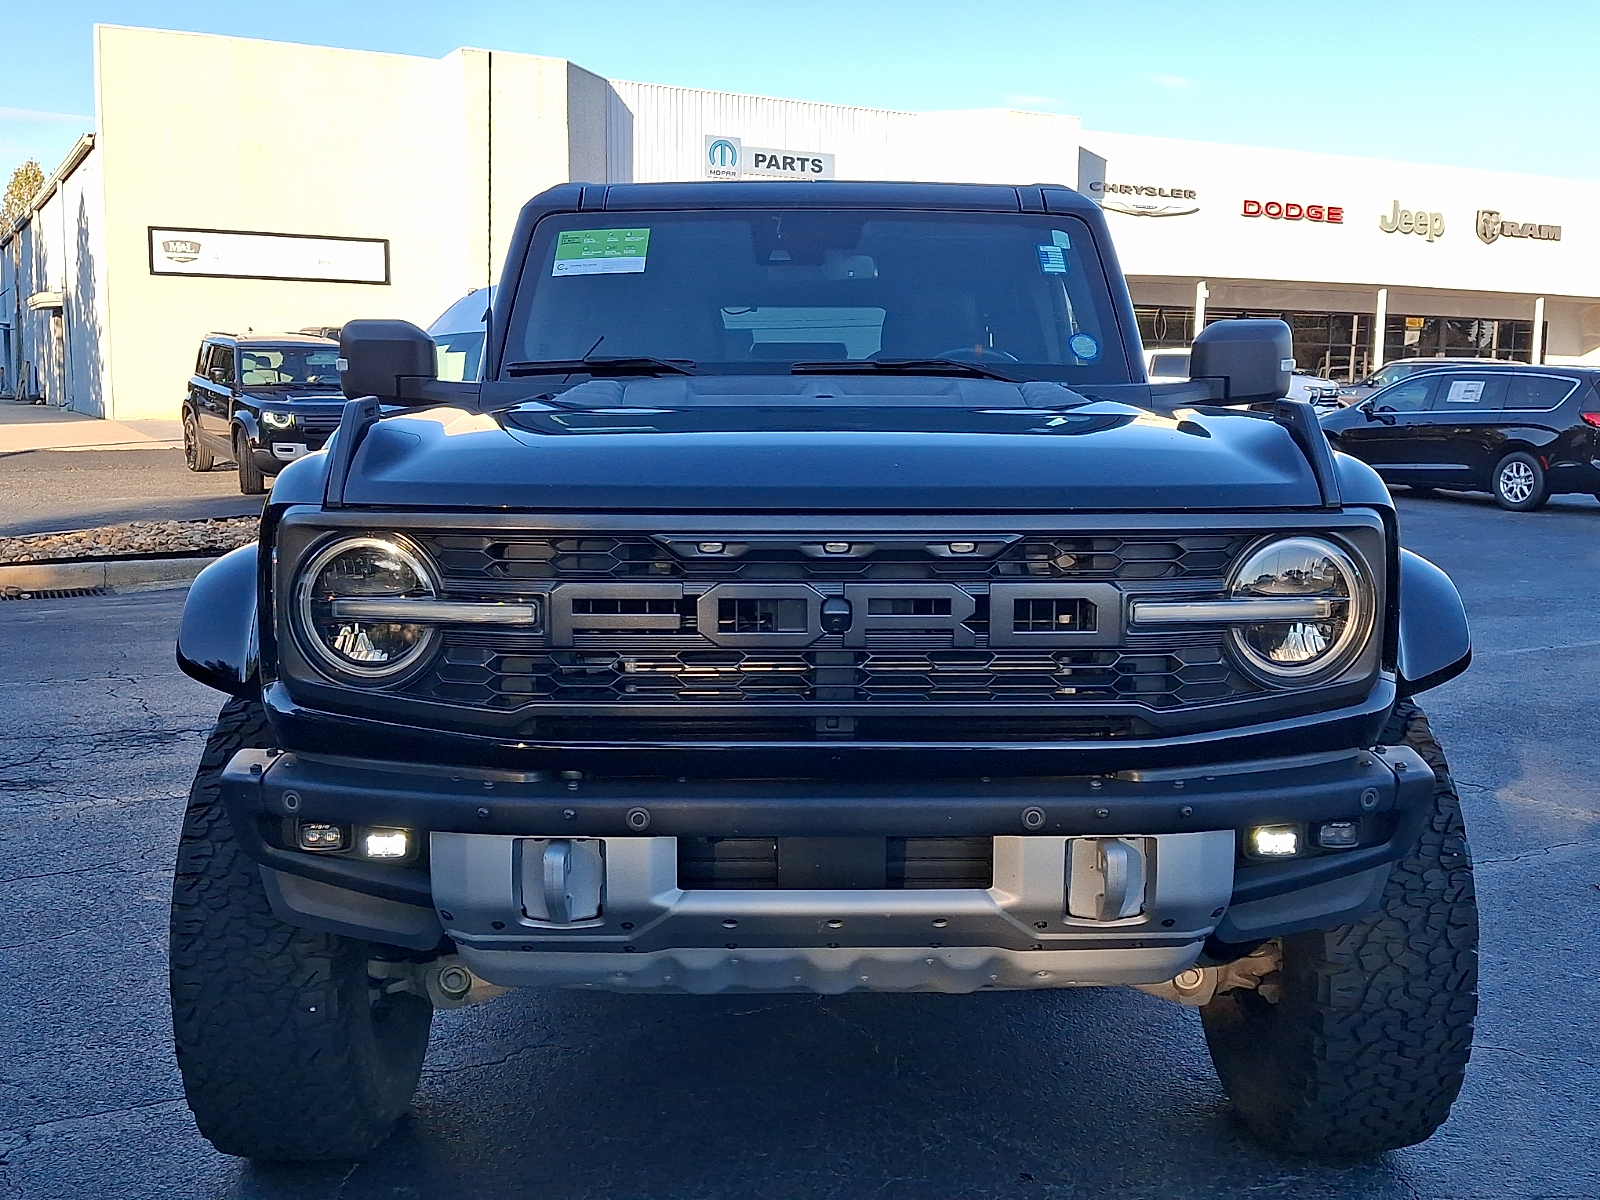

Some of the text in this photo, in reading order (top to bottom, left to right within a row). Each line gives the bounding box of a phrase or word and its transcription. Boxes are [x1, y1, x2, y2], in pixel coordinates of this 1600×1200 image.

[709, 169, 737, 177] MOPAR
[754, 152, 823, 174] PARTS
[1089, 181, 1197, 200] CHRYSLER
[1241, 199, 1344, 224] DODGE
[1379, 199, 1446, 242] Jeep
[1501, 220, 1562, 241] RAM
[548, 582, 1124, 649] FORD
